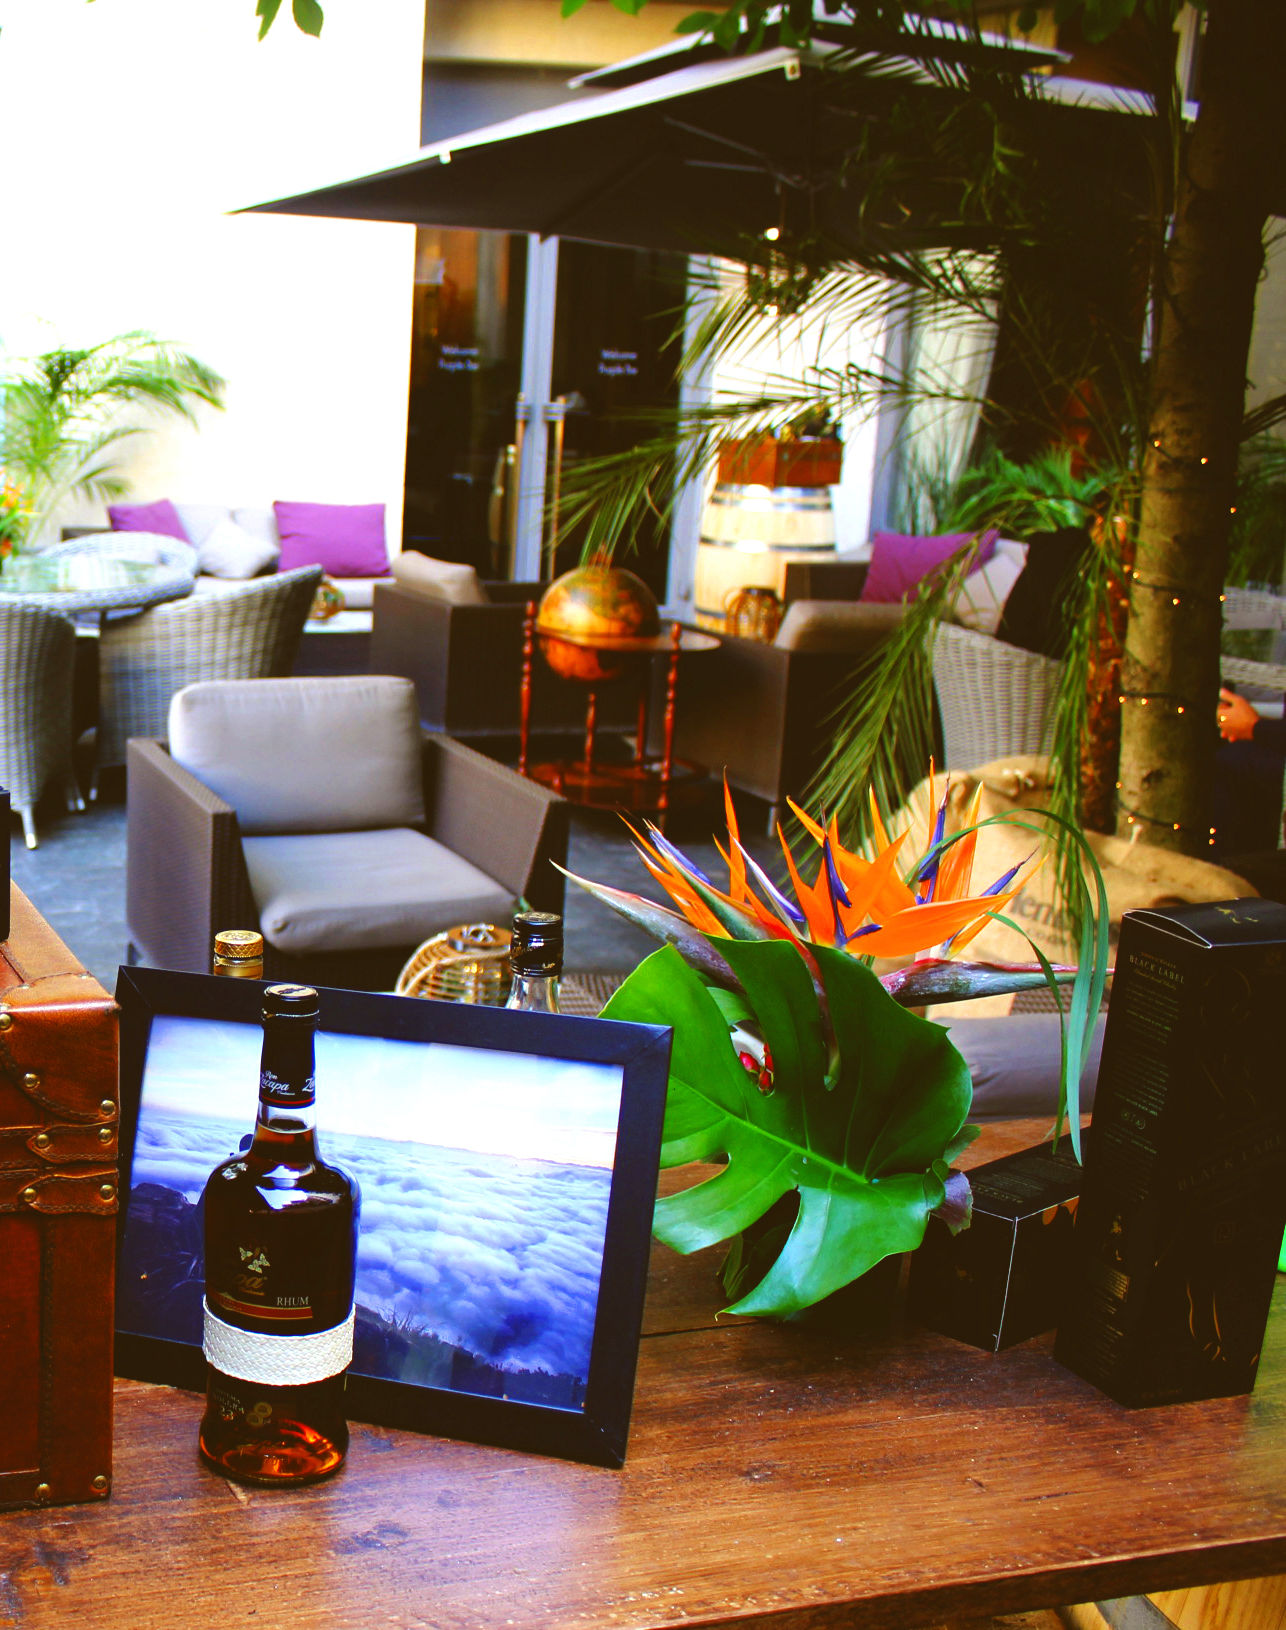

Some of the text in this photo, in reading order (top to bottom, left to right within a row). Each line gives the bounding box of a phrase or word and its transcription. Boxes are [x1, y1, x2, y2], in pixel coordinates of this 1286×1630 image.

[1129, 954, 1185, 984] BLACK LABEL
[276, 1295, 309, 1307] RHUM
